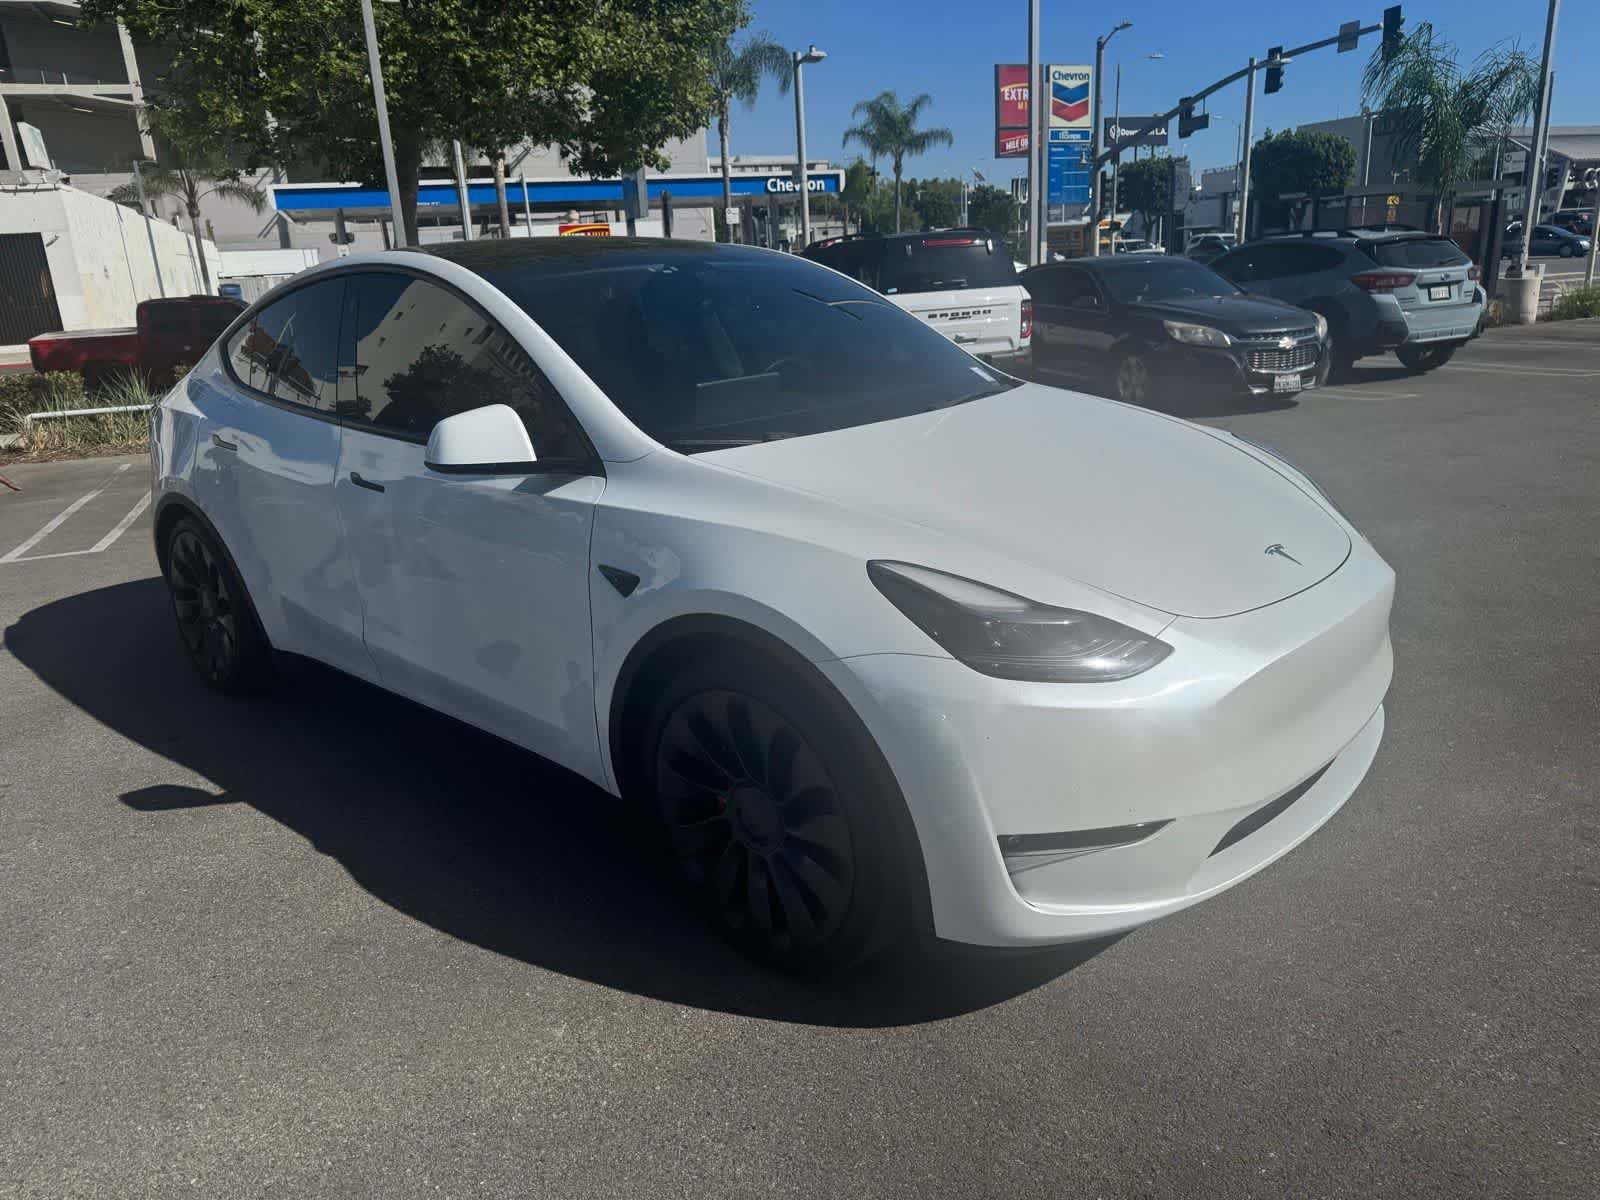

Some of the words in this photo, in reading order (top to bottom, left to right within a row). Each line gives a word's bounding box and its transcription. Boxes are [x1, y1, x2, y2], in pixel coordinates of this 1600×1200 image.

[1052, 71, 1090, 81] Chevron
[1004, 87, 1029, 101] EXTR
[767, 177, 825, 193] Chevon
